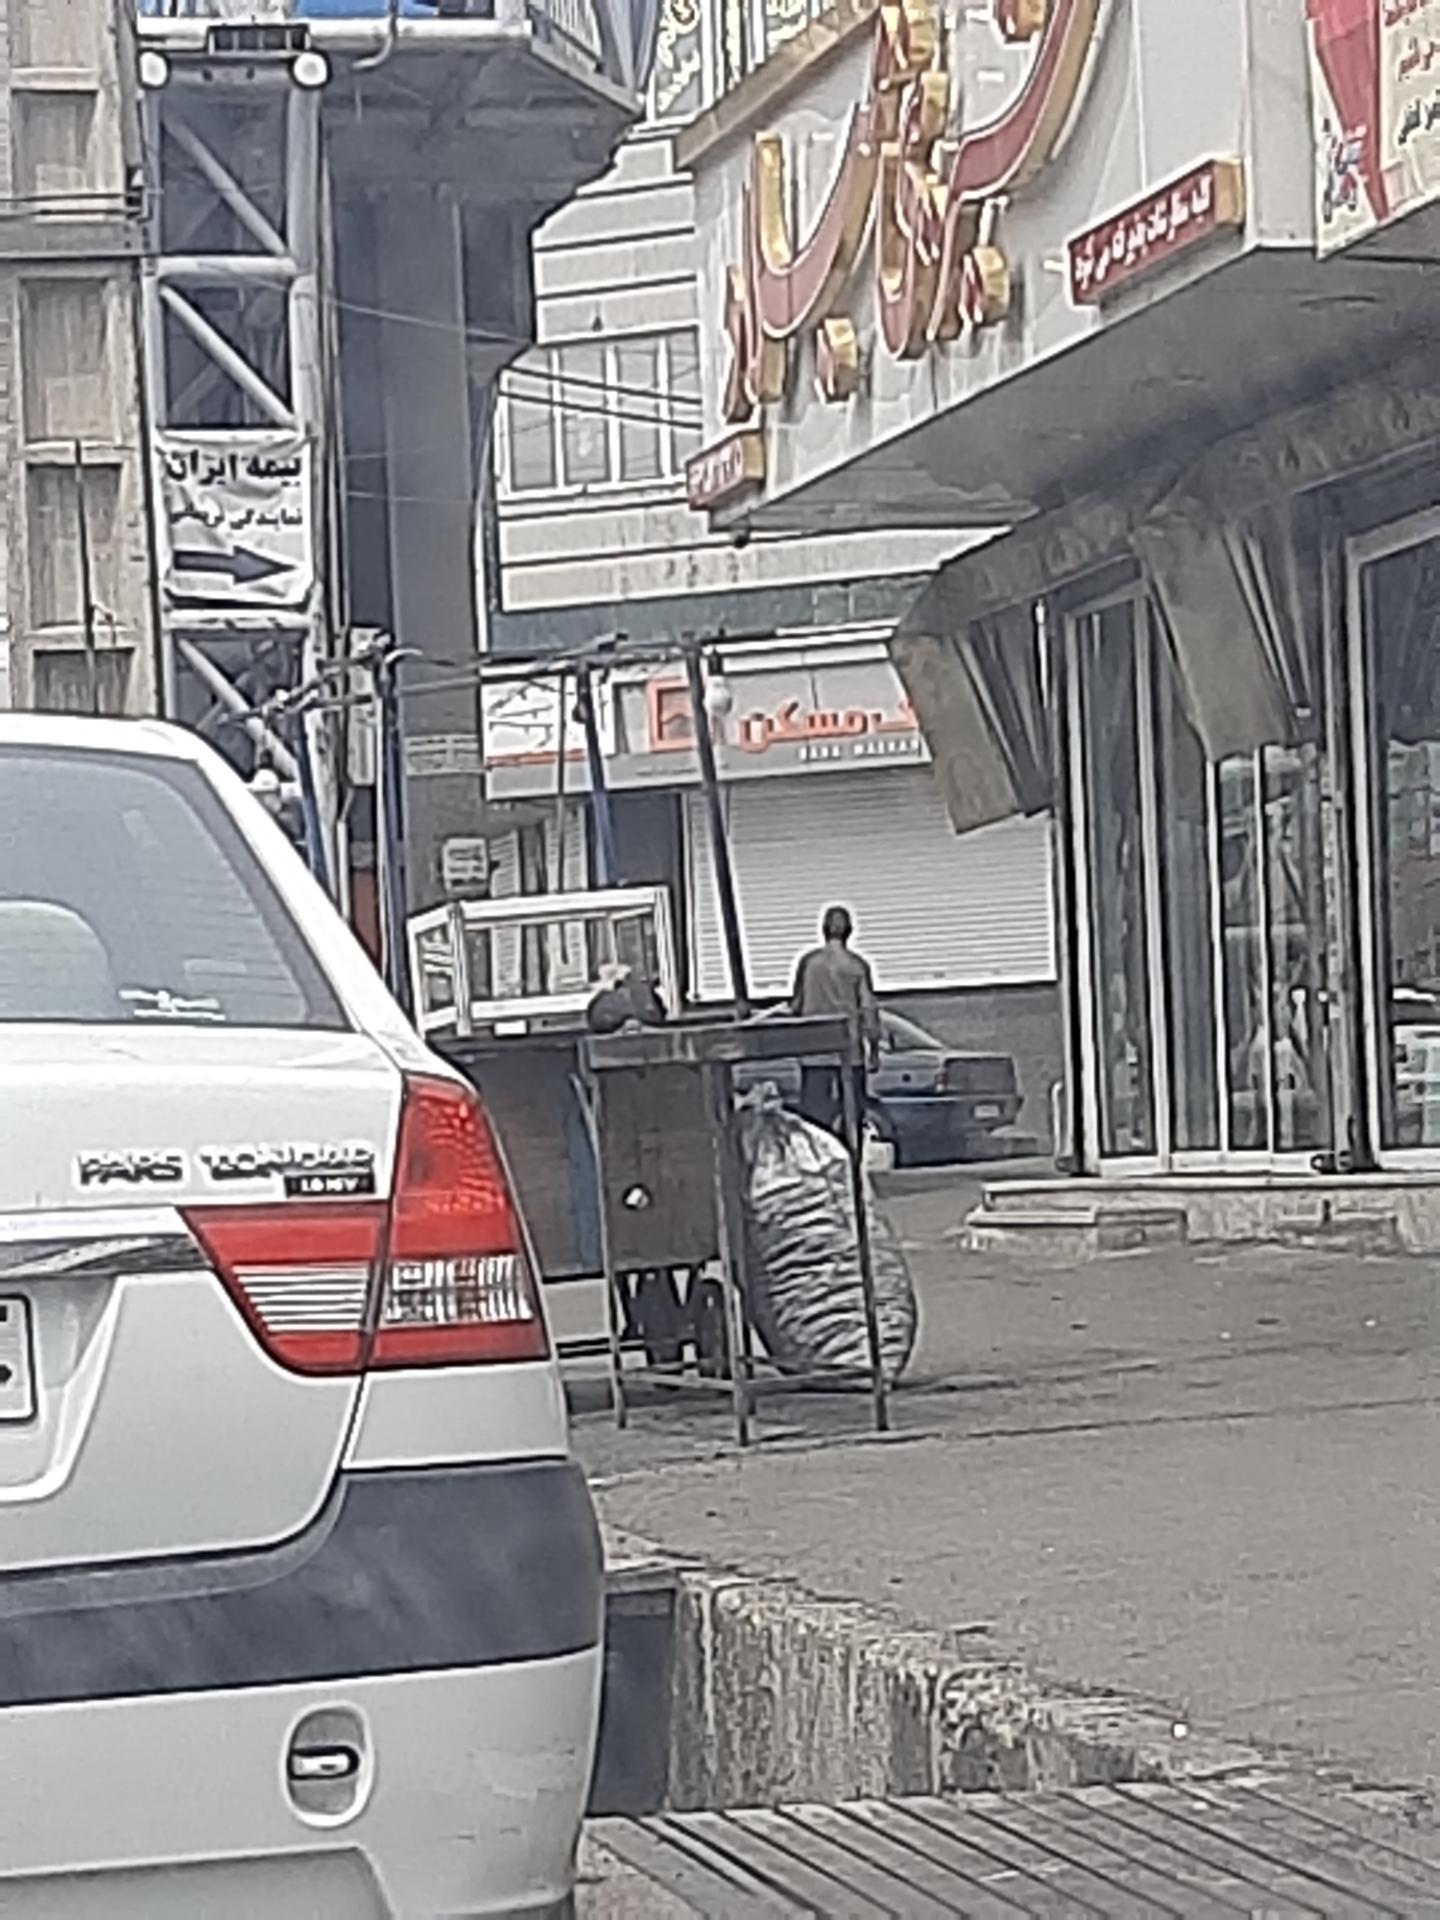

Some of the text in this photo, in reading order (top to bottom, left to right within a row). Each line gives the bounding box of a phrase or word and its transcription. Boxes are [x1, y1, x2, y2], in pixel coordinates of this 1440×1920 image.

[165, 449, 302, 487] بیمه ایران
[738, 702, 868, 753] مسکن
[77, 1150, 183, 1187] PARS
